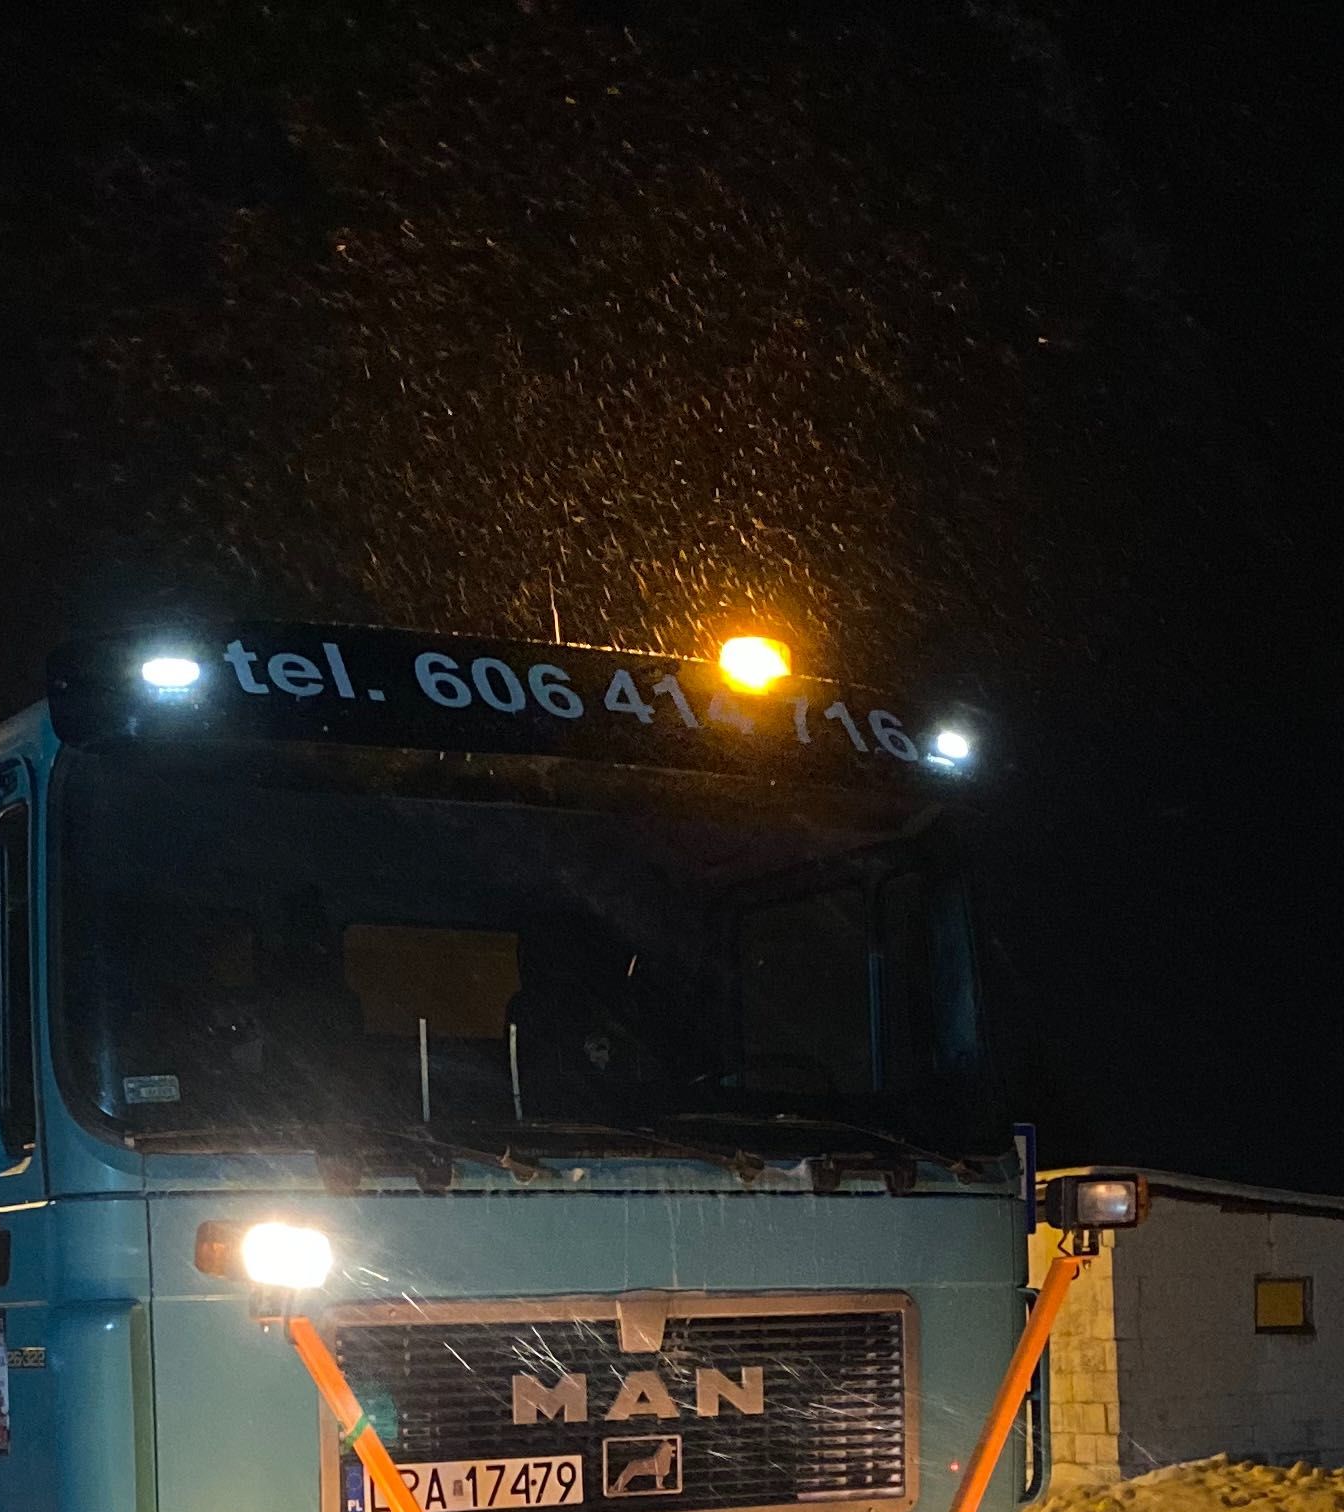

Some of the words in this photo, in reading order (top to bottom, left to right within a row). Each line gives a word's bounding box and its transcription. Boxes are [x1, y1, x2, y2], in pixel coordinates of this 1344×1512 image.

[223, 639, 386, 701] tel.
[414, 652, 584, 719] 606
[781, 694, 919, 761] 716
[512, 1366, 764, 1425] MAN
[347, 1499, 363, 1512] PL
[465, 1461, 577, 1508] 17479
